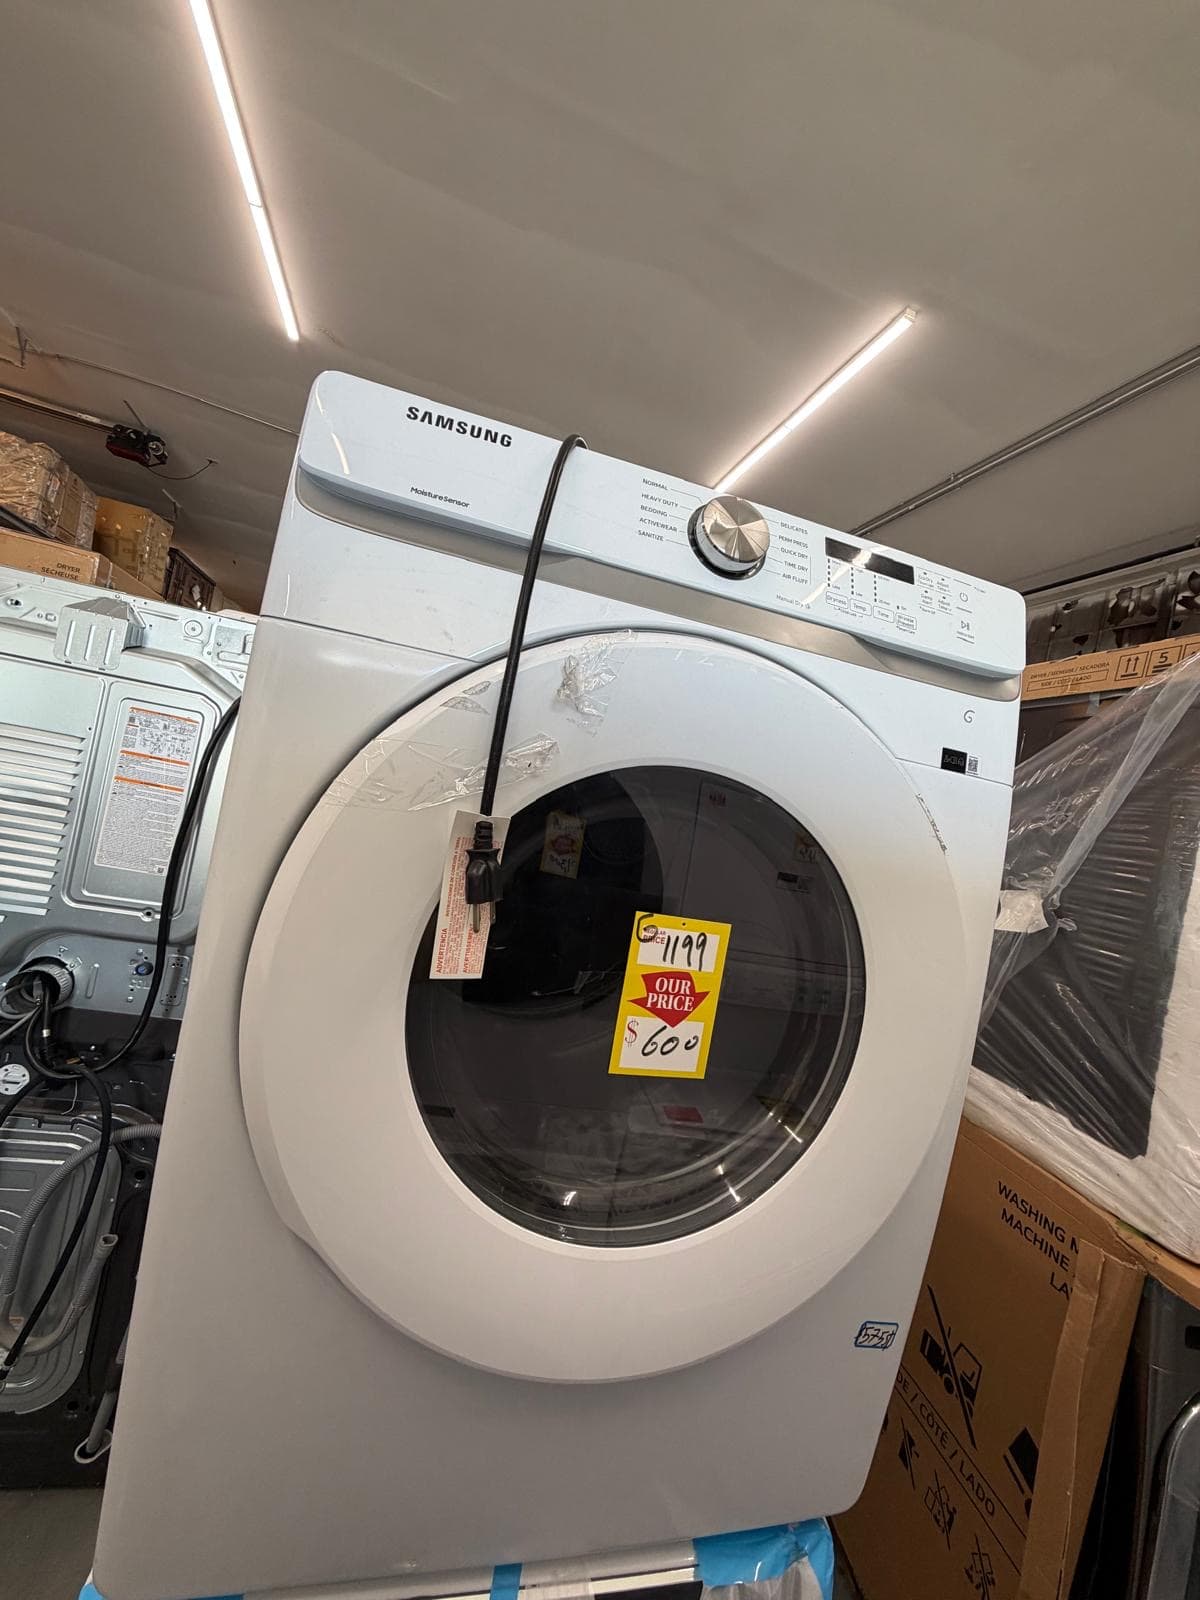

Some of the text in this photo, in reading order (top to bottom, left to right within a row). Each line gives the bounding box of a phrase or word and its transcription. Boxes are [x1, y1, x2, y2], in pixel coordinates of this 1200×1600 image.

[406, 406, 512, 448] SAMSUNG
[642, 478, 668, 490] NORMAL
[410, 486, 470, 507] MoistureSensor
[641, 493, 678, 507] HEAVY DUTY
[640, 504, 668, 517] BEDDING
[639, 517, 677, 531] ACTIVEWEAR
[780, 521, 808, 534] DELICATES
[638, 529, 664, 541] SANITIZE
[778, 535, 808, 549] PERM PRESS
[780, 547, 808, 560] QUICK DRY
[56, 562, 81, 574] DRYER
[784, 560, 808, 573] TIME DRY
[792, 575, 808, 585] FLUFF
[1158, 651, 1168, 663] 5
[1079, 662, 1110, 671] SECADORA
[436, 928, 448, 973] ADVERTENCIA
[663, 932, 707, 972] 1199
[655, 977, 691, 995] OUR
[646, 992, 695, 1012] PRICE
[624, 1018, 699, 1056] $ 600
[998, 1181, 1066, 1244] WASHING
[1001, 1208, 1070, 1272] MACHINE
[1050, 1271, 1073, 1301] LA
[959, 1460, 995, 1518] LADO
